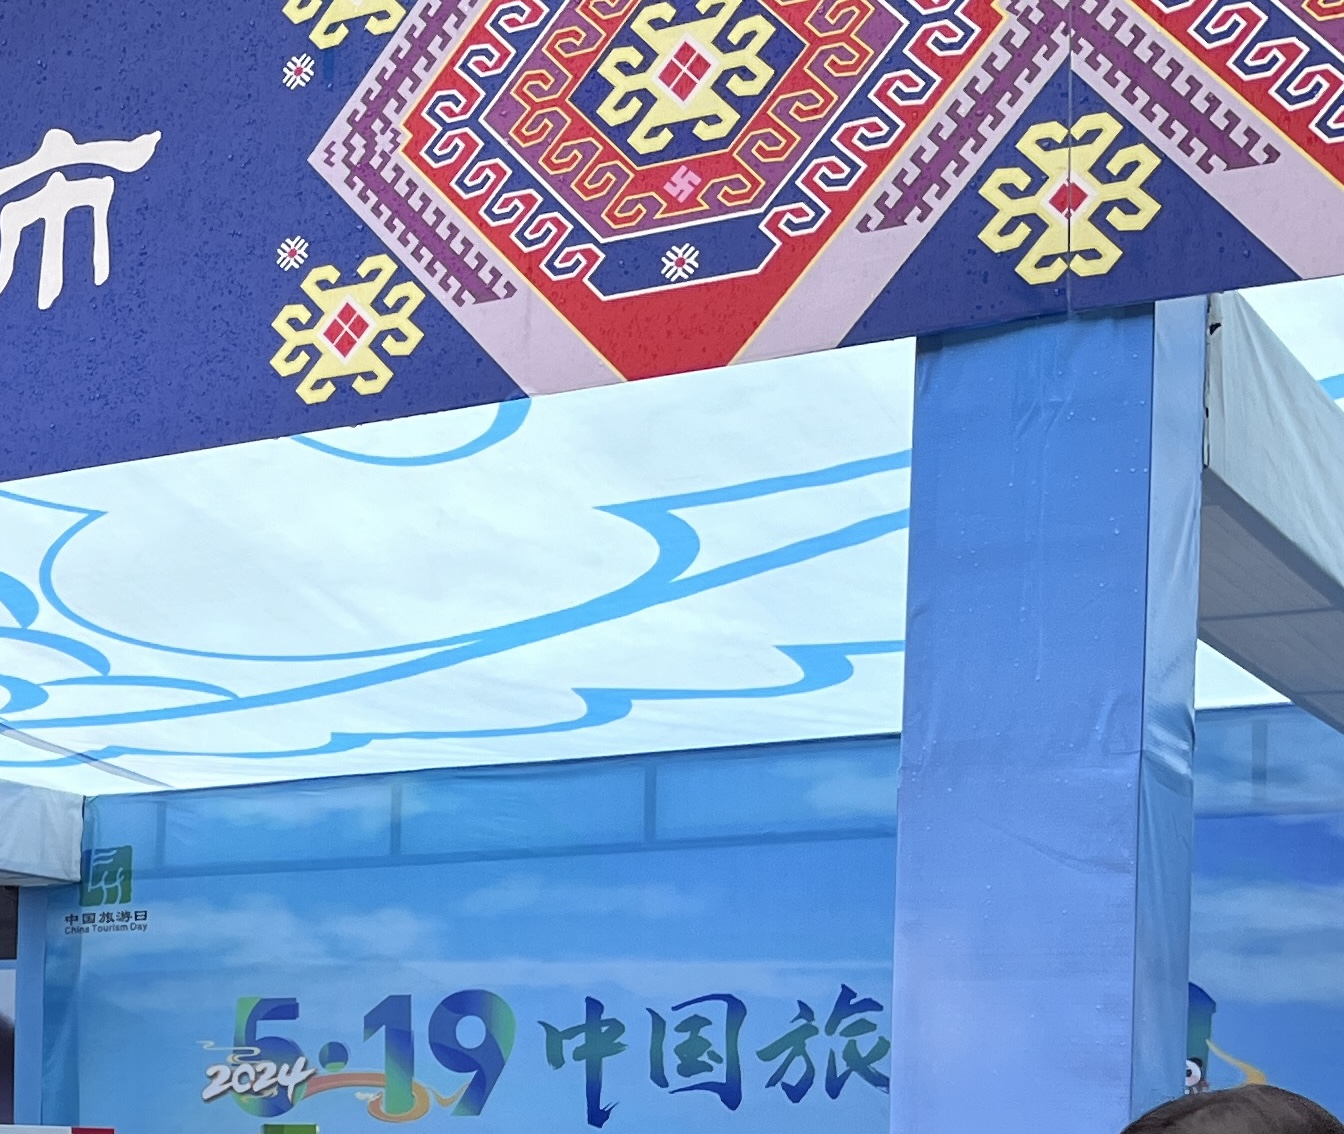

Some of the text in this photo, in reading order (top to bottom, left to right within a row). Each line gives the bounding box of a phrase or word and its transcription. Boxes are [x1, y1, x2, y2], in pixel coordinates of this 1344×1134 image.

[64, 911, 148, 926] 中国旅游日
[64, 922, 148, 935] China Tourism Day
[203, 1055, 313, 1101] 2024
